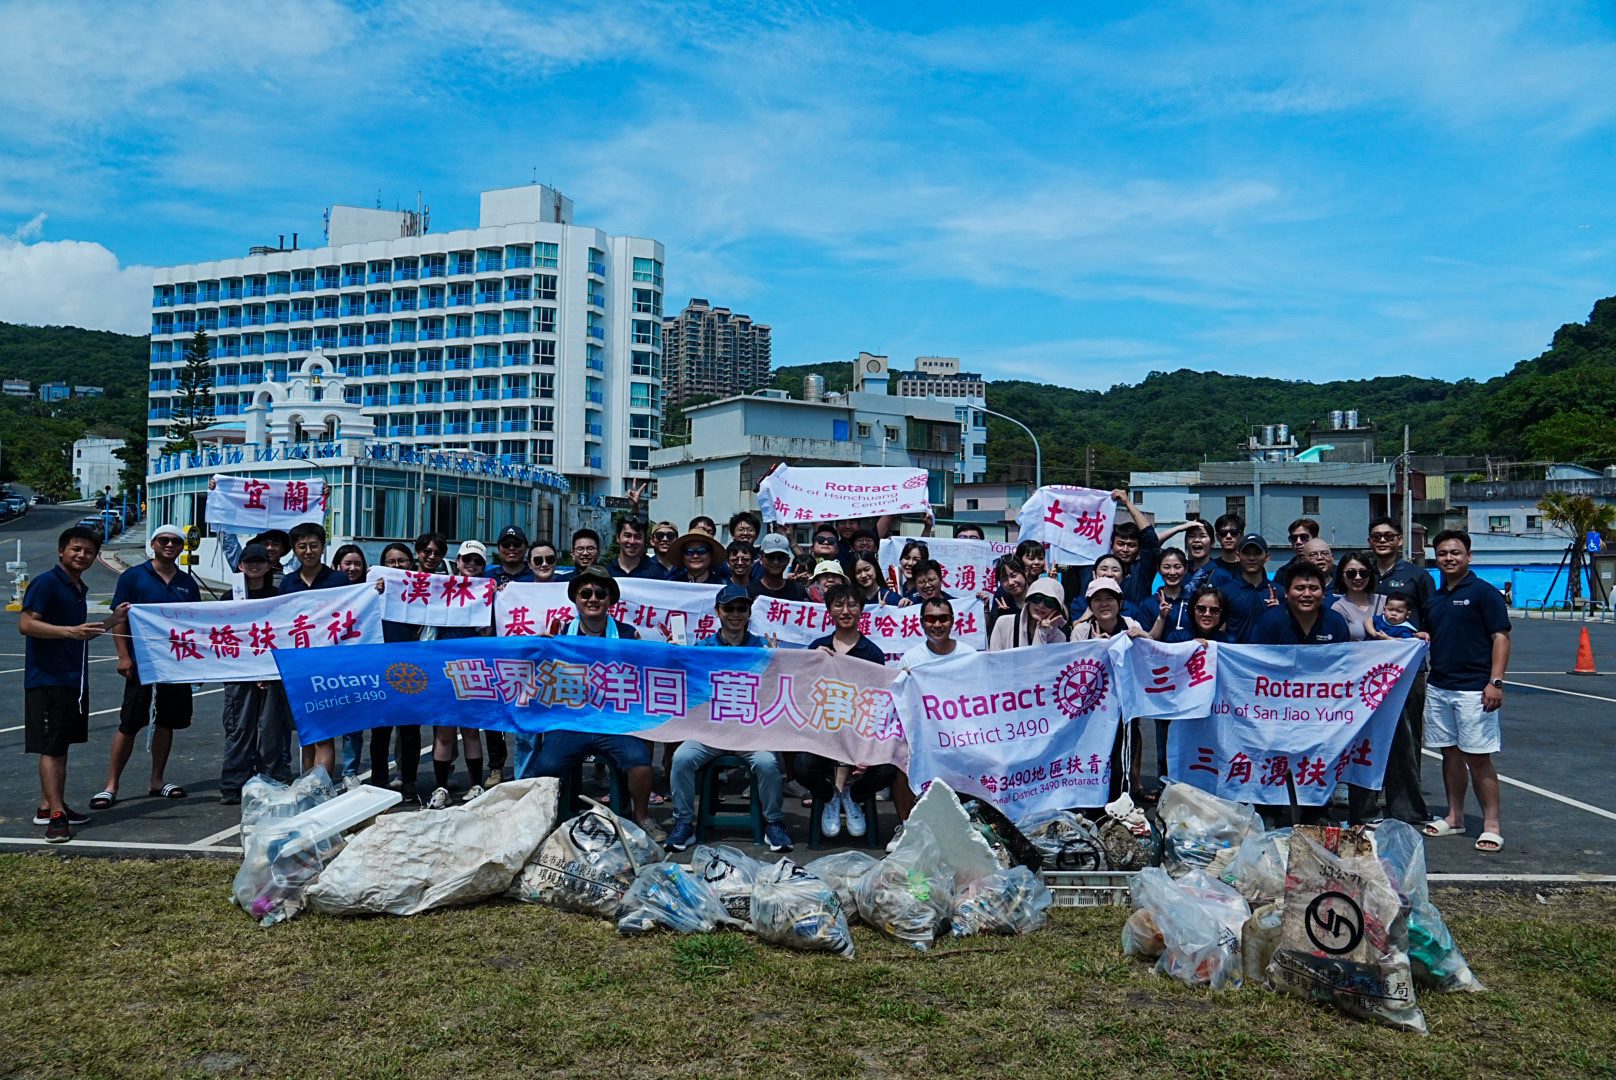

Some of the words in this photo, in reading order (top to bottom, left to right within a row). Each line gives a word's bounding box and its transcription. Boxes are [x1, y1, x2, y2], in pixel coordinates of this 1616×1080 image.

[824, 492, 898, 502] Hsinchuang
[825, 482, 898, 493] Rotaract
[851, 498, 898, 508] Central
[1044, 499, 1106, 545] 土城
[608, 601, 716, 640] 新北桌
[767, 601, 978, 638] 新北羅哈扶社
[169, 611, 361, 661] 板橋扶青社
[311, 674, 380, 693] Rotary
[1144, 650, 1214, 693] 三重
[444, 658, 687, 718] 世界海洋日
[1255, 676, 1354, 698] Rotaract
[304, 695, 351, 714] District
[353, 690, 387, 703] 3490
[922, 684, 1046, 721] Rotaract
[1210, 702, 1230, 715] lub
[1235, 703, 1249, 718] of
[1254, 705, 1278, 720] San
[1282, 706, 1310, 721] Jiao
[1315, 707, 1354, 725] Yung
[938, 727, 1003, 748] District
[1005, 717, 1049, 740] 3490
[1013, 788, 1038, 802] District
[1040, 780, 1060, 793] 3490
[1062, 778, 1099, 787] Rotaract
